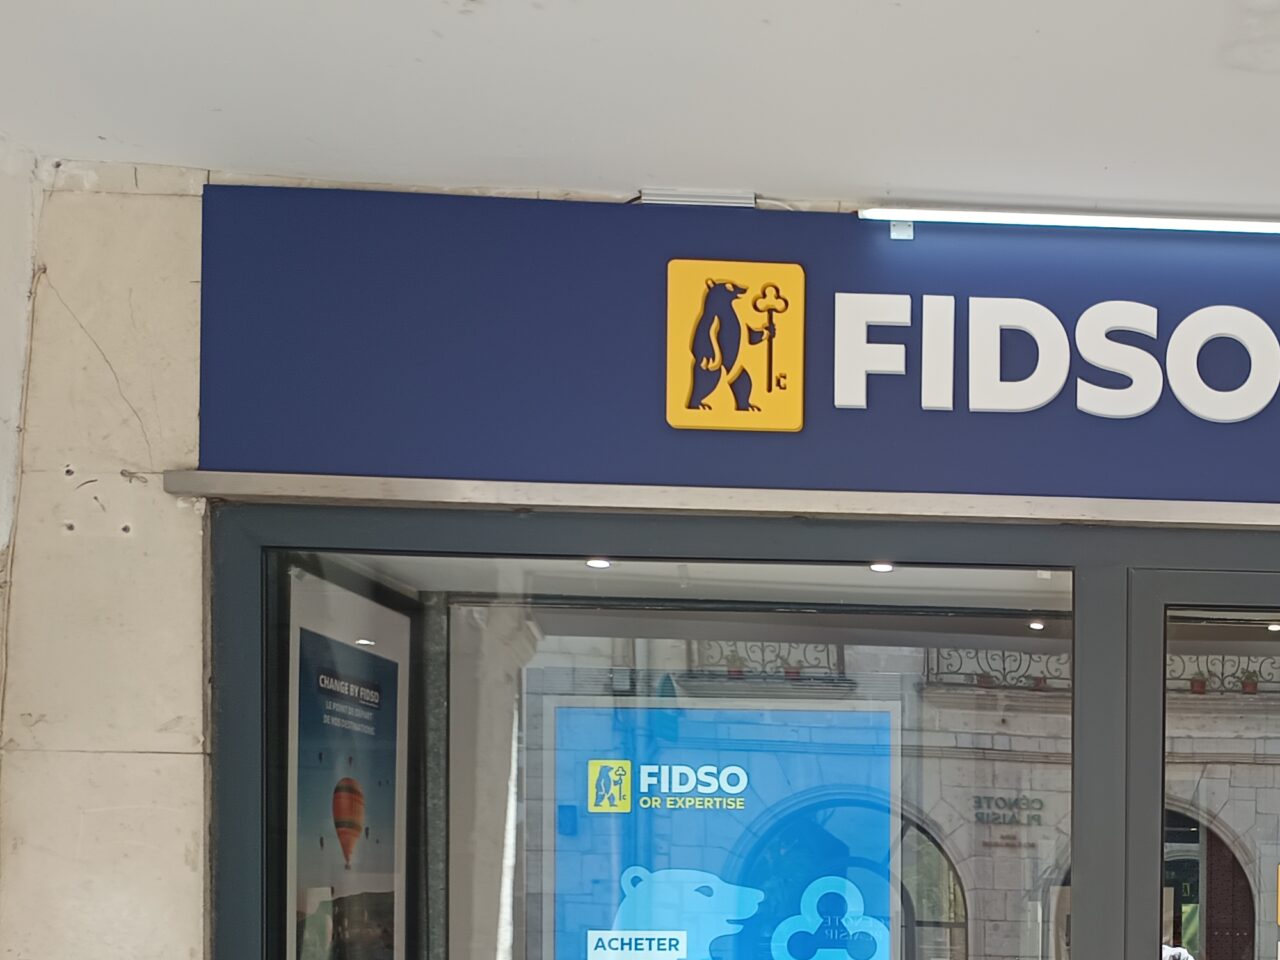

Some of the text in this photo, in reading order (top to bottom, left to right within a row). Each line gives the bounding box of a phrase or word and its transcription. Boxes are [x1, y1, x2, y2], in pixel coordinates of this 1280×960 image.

[639, 765, 748, 794] FIDSO
[639, 797, 745, 809] OR EXPERTISE
[594, 938, 680, 951] ACHETER
